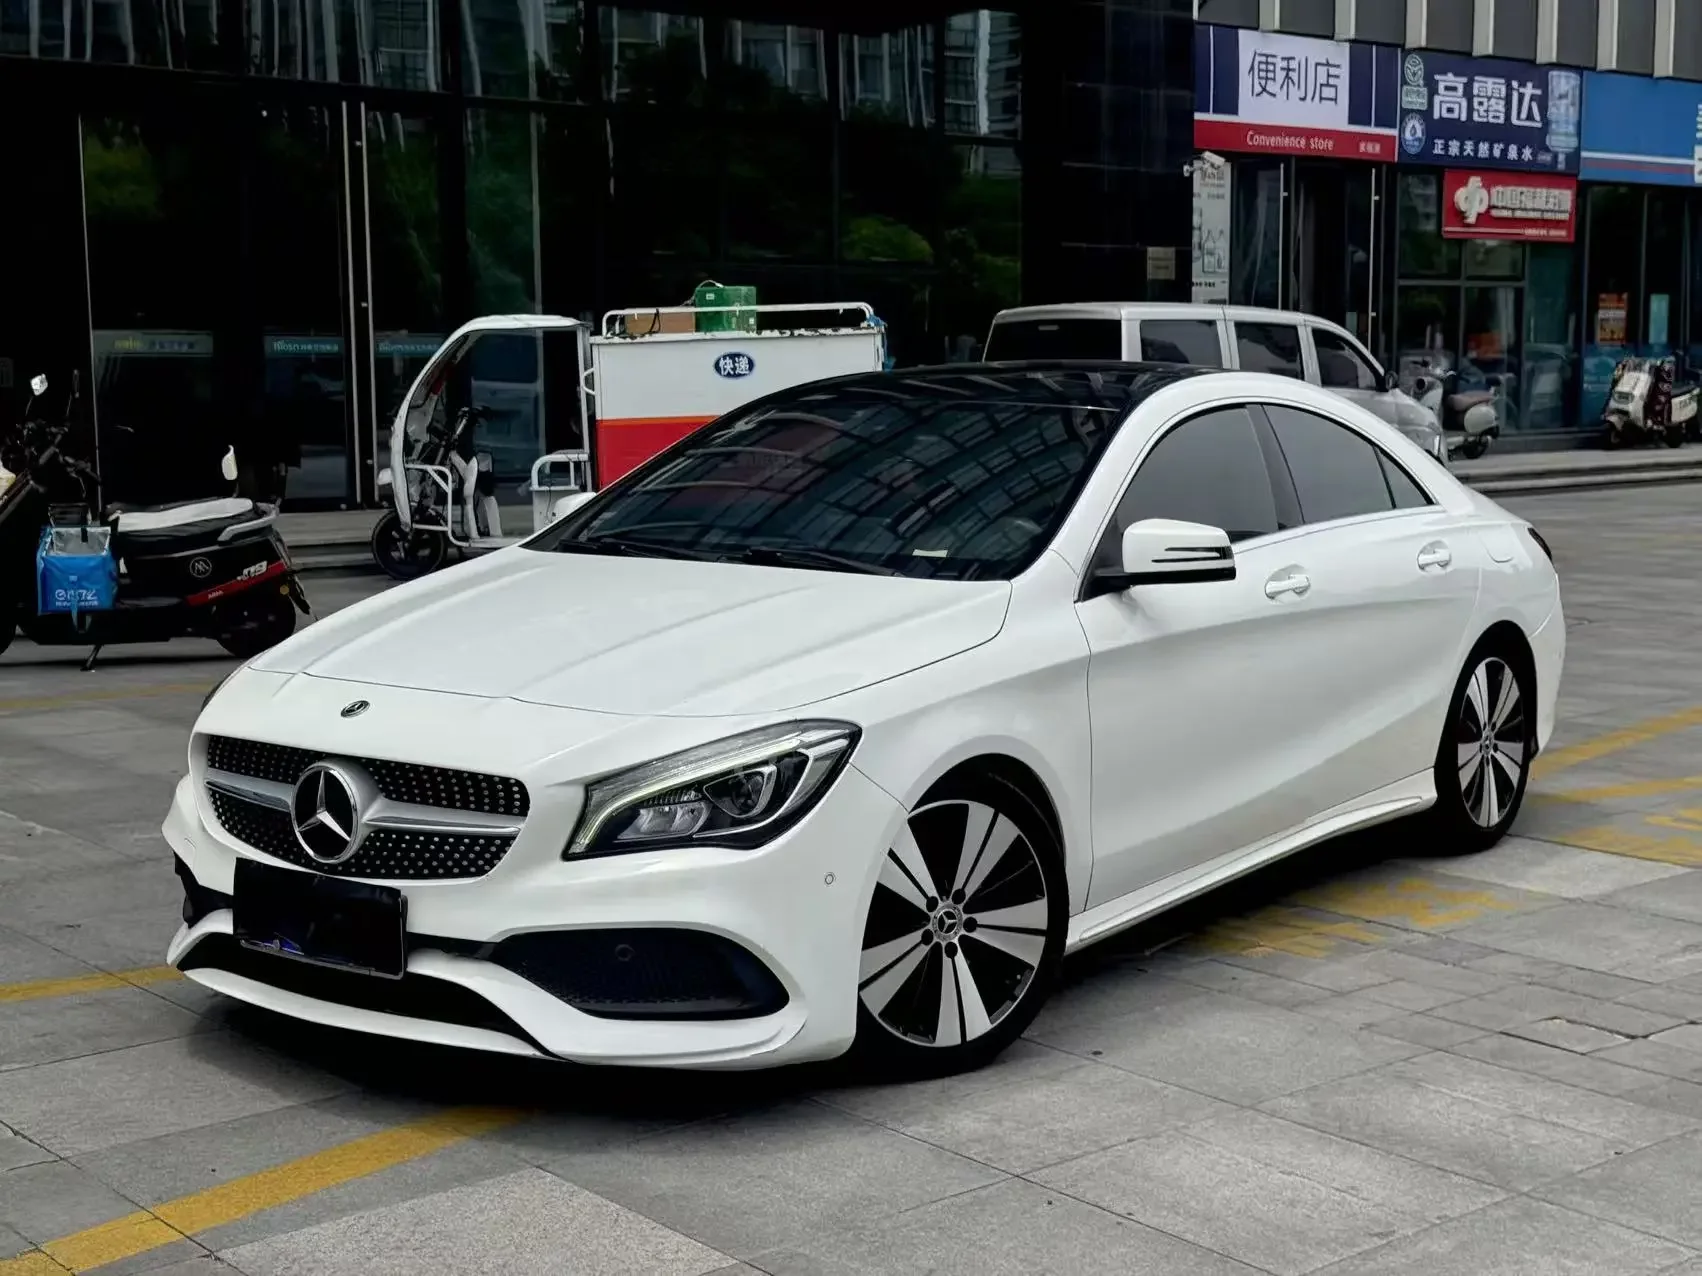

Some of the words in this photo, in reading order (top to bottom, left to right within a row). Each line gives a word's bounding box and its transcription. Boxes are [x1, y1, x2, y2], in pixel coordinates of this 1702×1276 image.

[1248, 50, 1342, 105] 便利店
[1433, 72, 1543, 128] 高露达
[1246, 129, 1306, 149] Convenience
[1310, 135, 1334, 150] store
[1432, 138, 1533, 161] 正宗天然矿泉水
[719, 356, 749, 375] 快递
